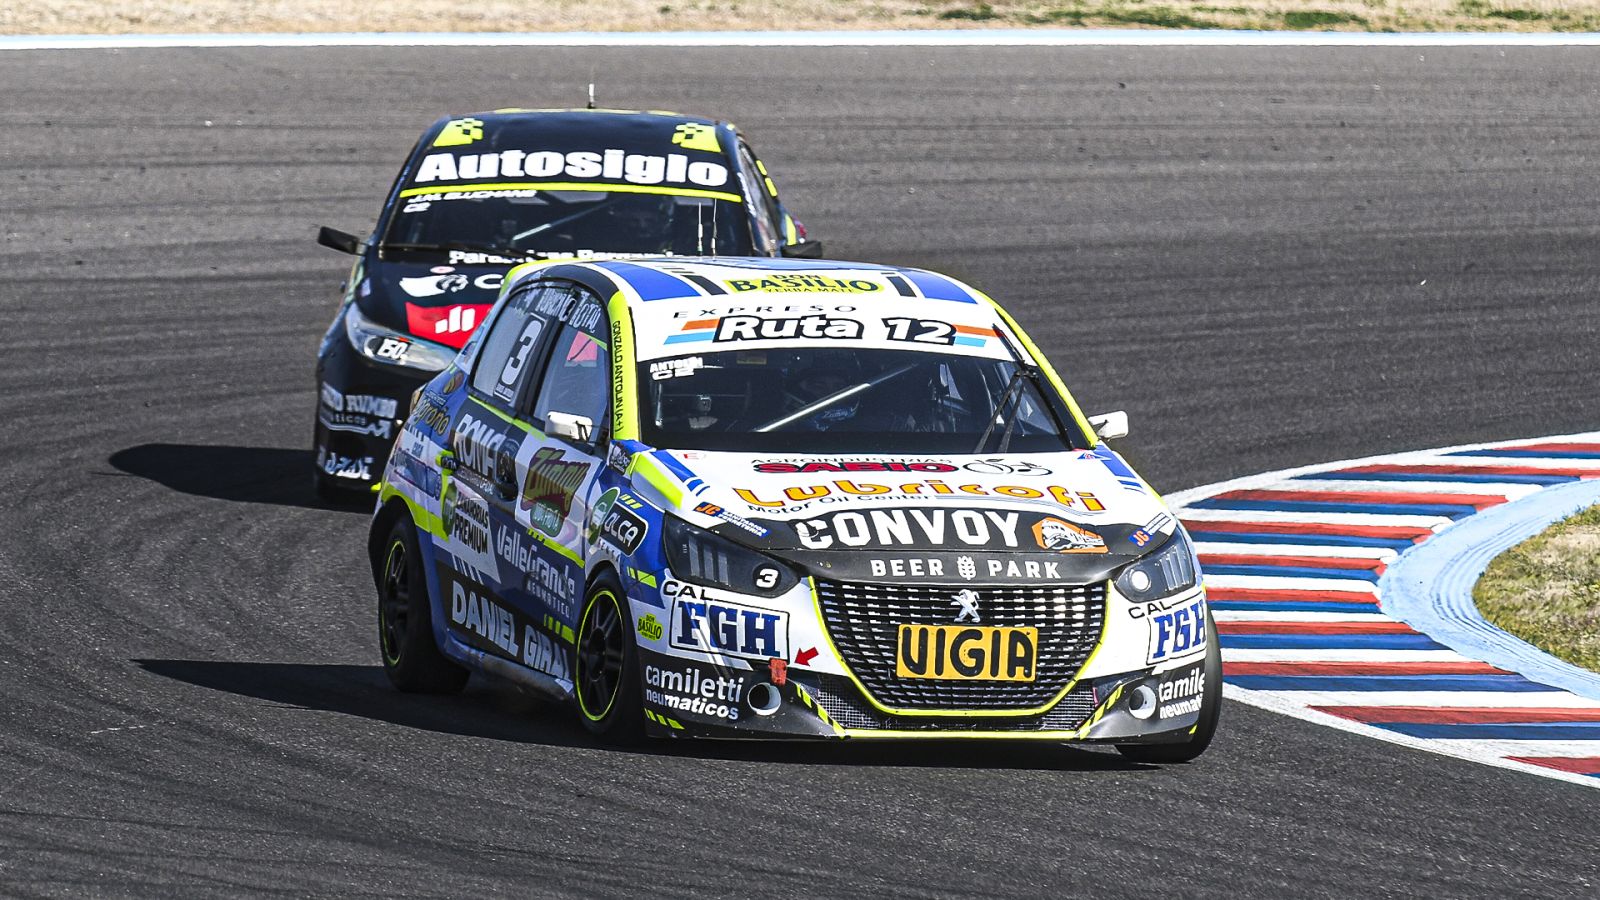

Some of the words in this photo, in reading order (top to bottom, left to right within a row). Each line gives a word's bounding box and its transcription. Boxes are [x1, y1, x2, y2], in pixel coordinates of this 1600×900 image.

[414, 148, 728, 187] Autosiglo
[730, 279, 879, 292] BASILIO
[673, 305, 857, 319] EXPRESO
[713, 314, 864, 343] Ruta
[881, 316, 957, 346] 12
[501, 320, 542, 385] 3
[753, 462, 959, 473] SABIO
[732, 480, 1106, 512] Lubricofi
[696, 503, 721, 515] JC
[747, 502, 811, 515] Motor
[797, 509, 1019, 550] CONVOY
[756, 568, 779, 588] 3
[870, 559, 944, 577] BEER
[987, 560, 1061, 579] PARK
[663, 580, 714, 600] CAL
[1128, 600, 1172, 619] CAL
[637, 617, 662, 640] BASILIO
[677, 601, 780, 657] FGH
[901, 626, 1034, 679] VIGIA
[645, 664, 744, 703] camiletti
[645, 688, 739, 720] neumaticos
